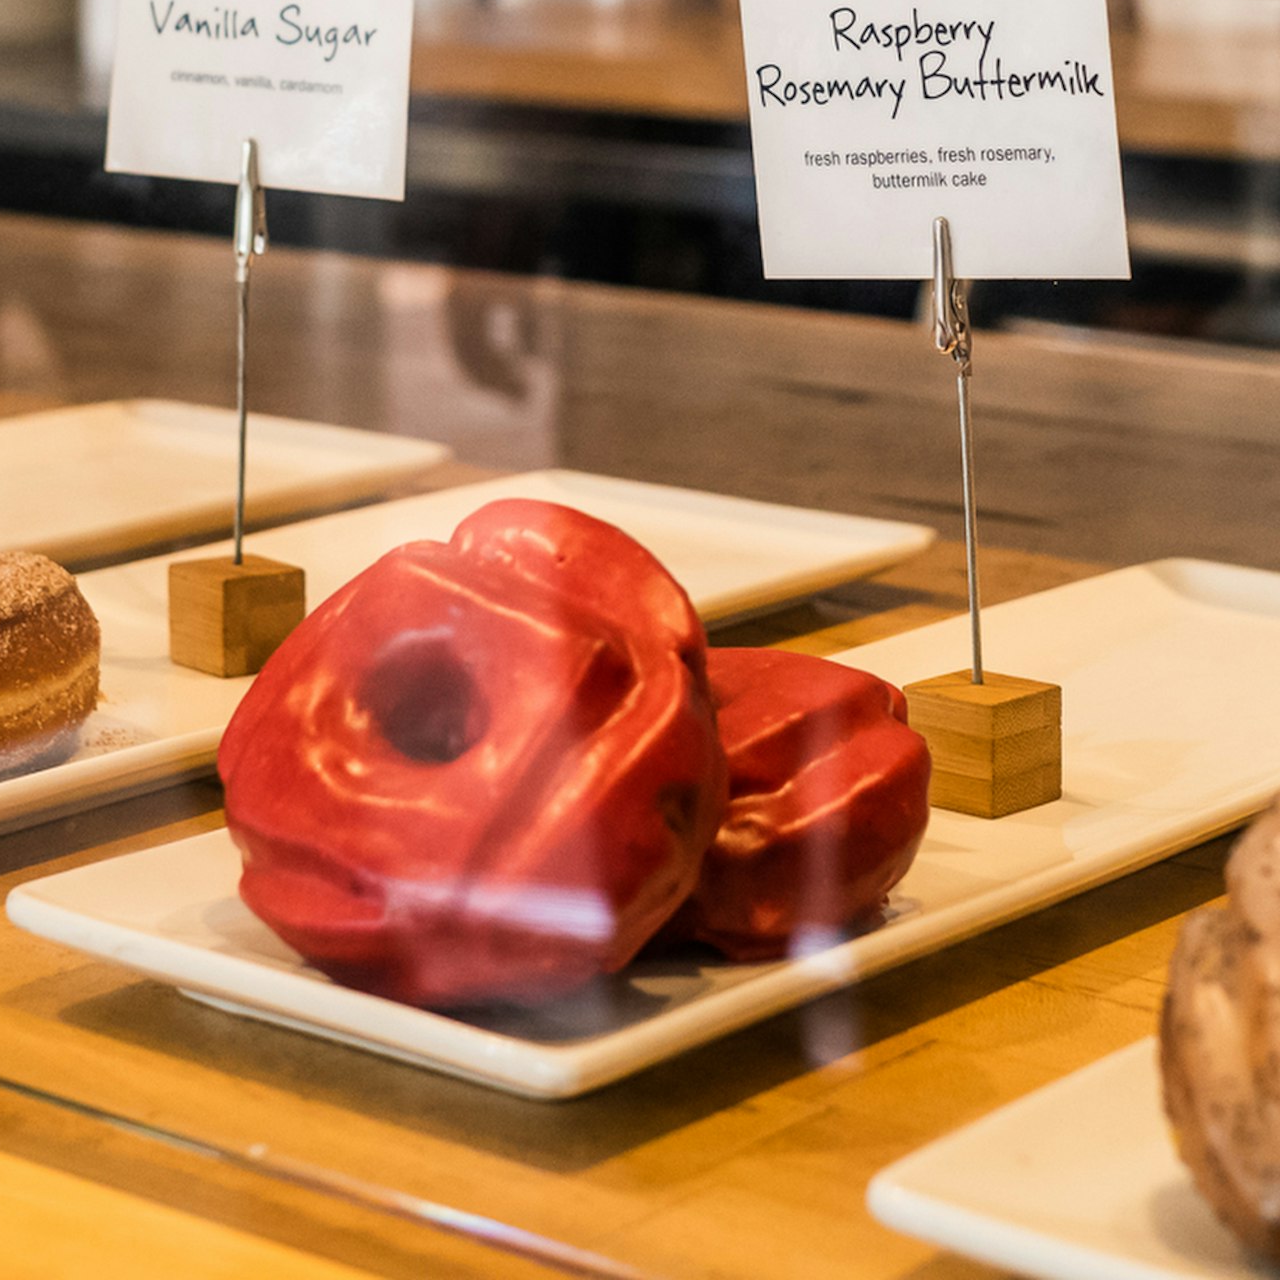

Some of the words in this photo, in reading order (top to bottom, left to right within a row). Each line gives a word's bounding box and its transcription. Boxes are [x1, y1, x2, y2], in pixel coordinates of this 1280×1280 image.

[150, 0, 259, 40] Vanilla
[276, 4, 378, 62] Sugar
[829, 7, 995, 62] Raspberry
[280, 77, 343, 95] cardamom
[756, 64, 905, 119] Rosemary
[919, 51, 1104, 100] Buttermilk
[804, 150, 841, 167] fresh
[845, 149, 933, 168] raspberries,
[937, 147, 976, 163] fresh
[980, 147, 1056, 166] rosemary,
[872, 172, 948, 190] buttermilk
[952, 171, 987, 188] cake
